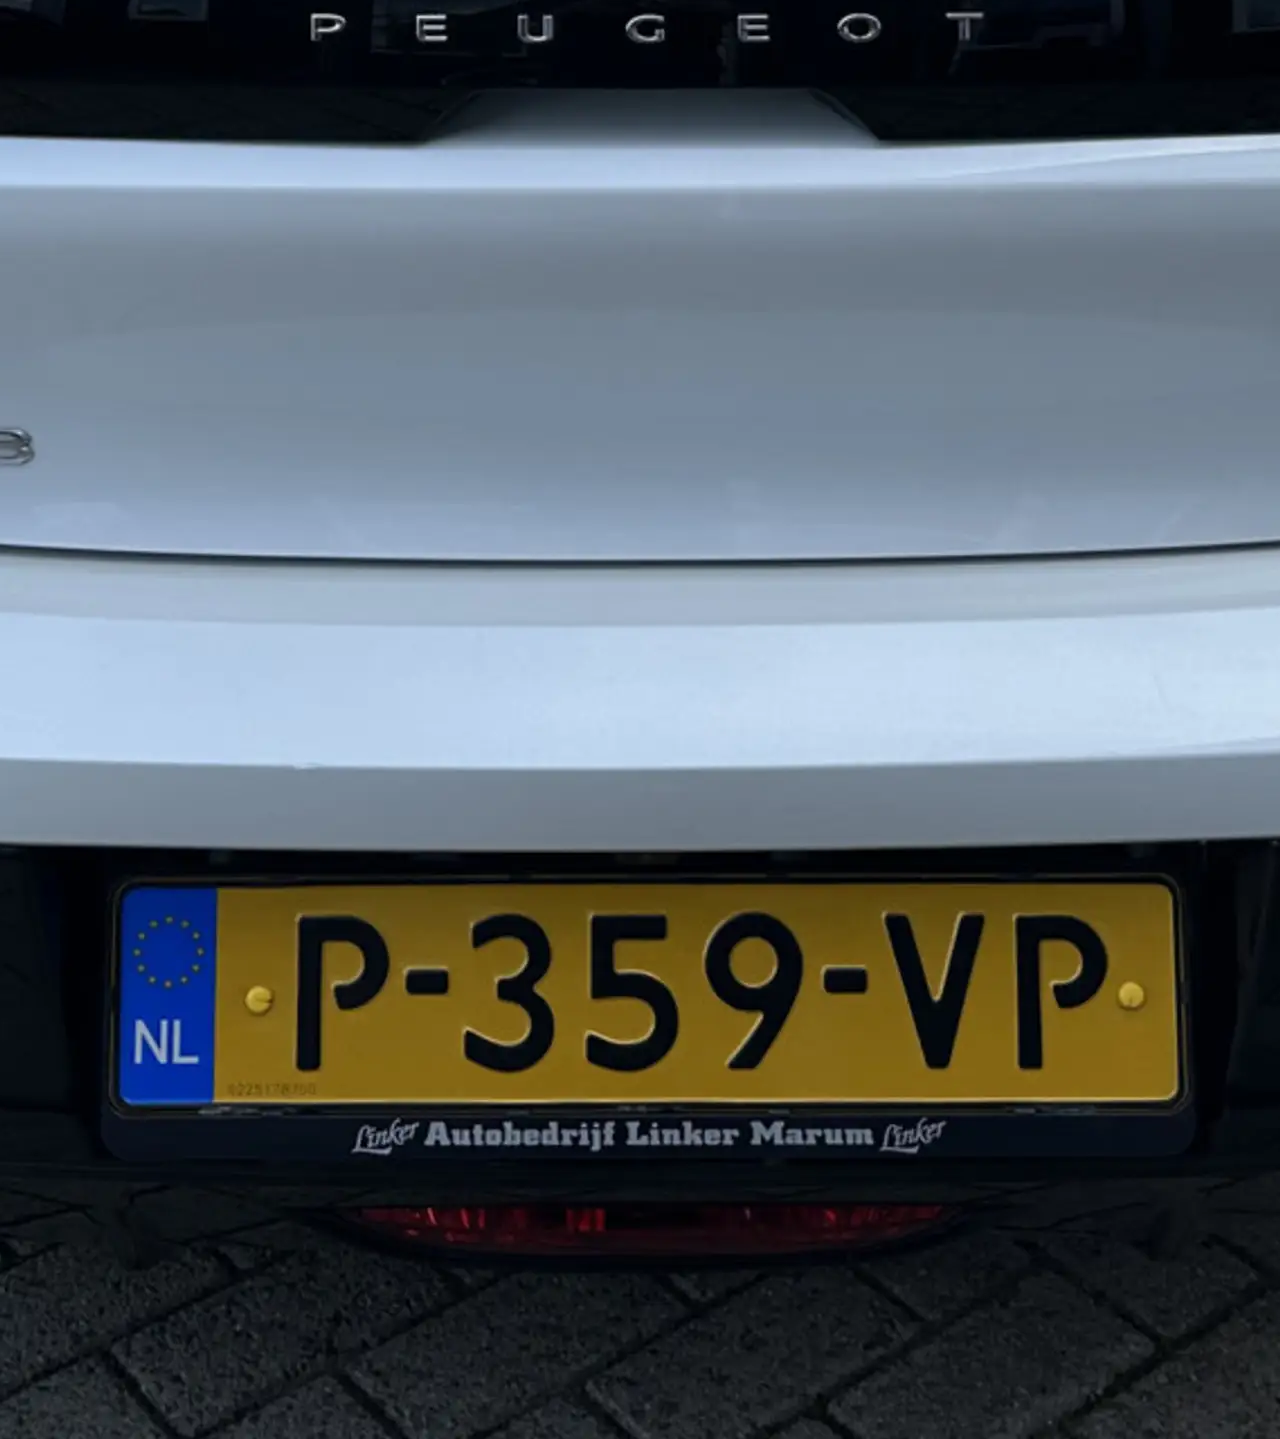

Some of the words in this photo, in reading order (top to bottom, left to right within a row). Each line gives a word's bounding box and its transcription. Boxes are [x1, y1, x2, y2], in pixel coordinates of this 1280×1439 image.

[309, 11, 984, 43] PEUGEOT
[294, 910, 1110, 1074] P-359-VP
[133, 1019, 200, 1065] NL
[351, 1117, 420, 1156] Linker
[424, 1119, 615, 1153] Autobedrijf
[626, 1120, 741, 1147] Linker
[750, 1121, 875, 1147] Marum
[879, 1117, 947, 1155] Linker
